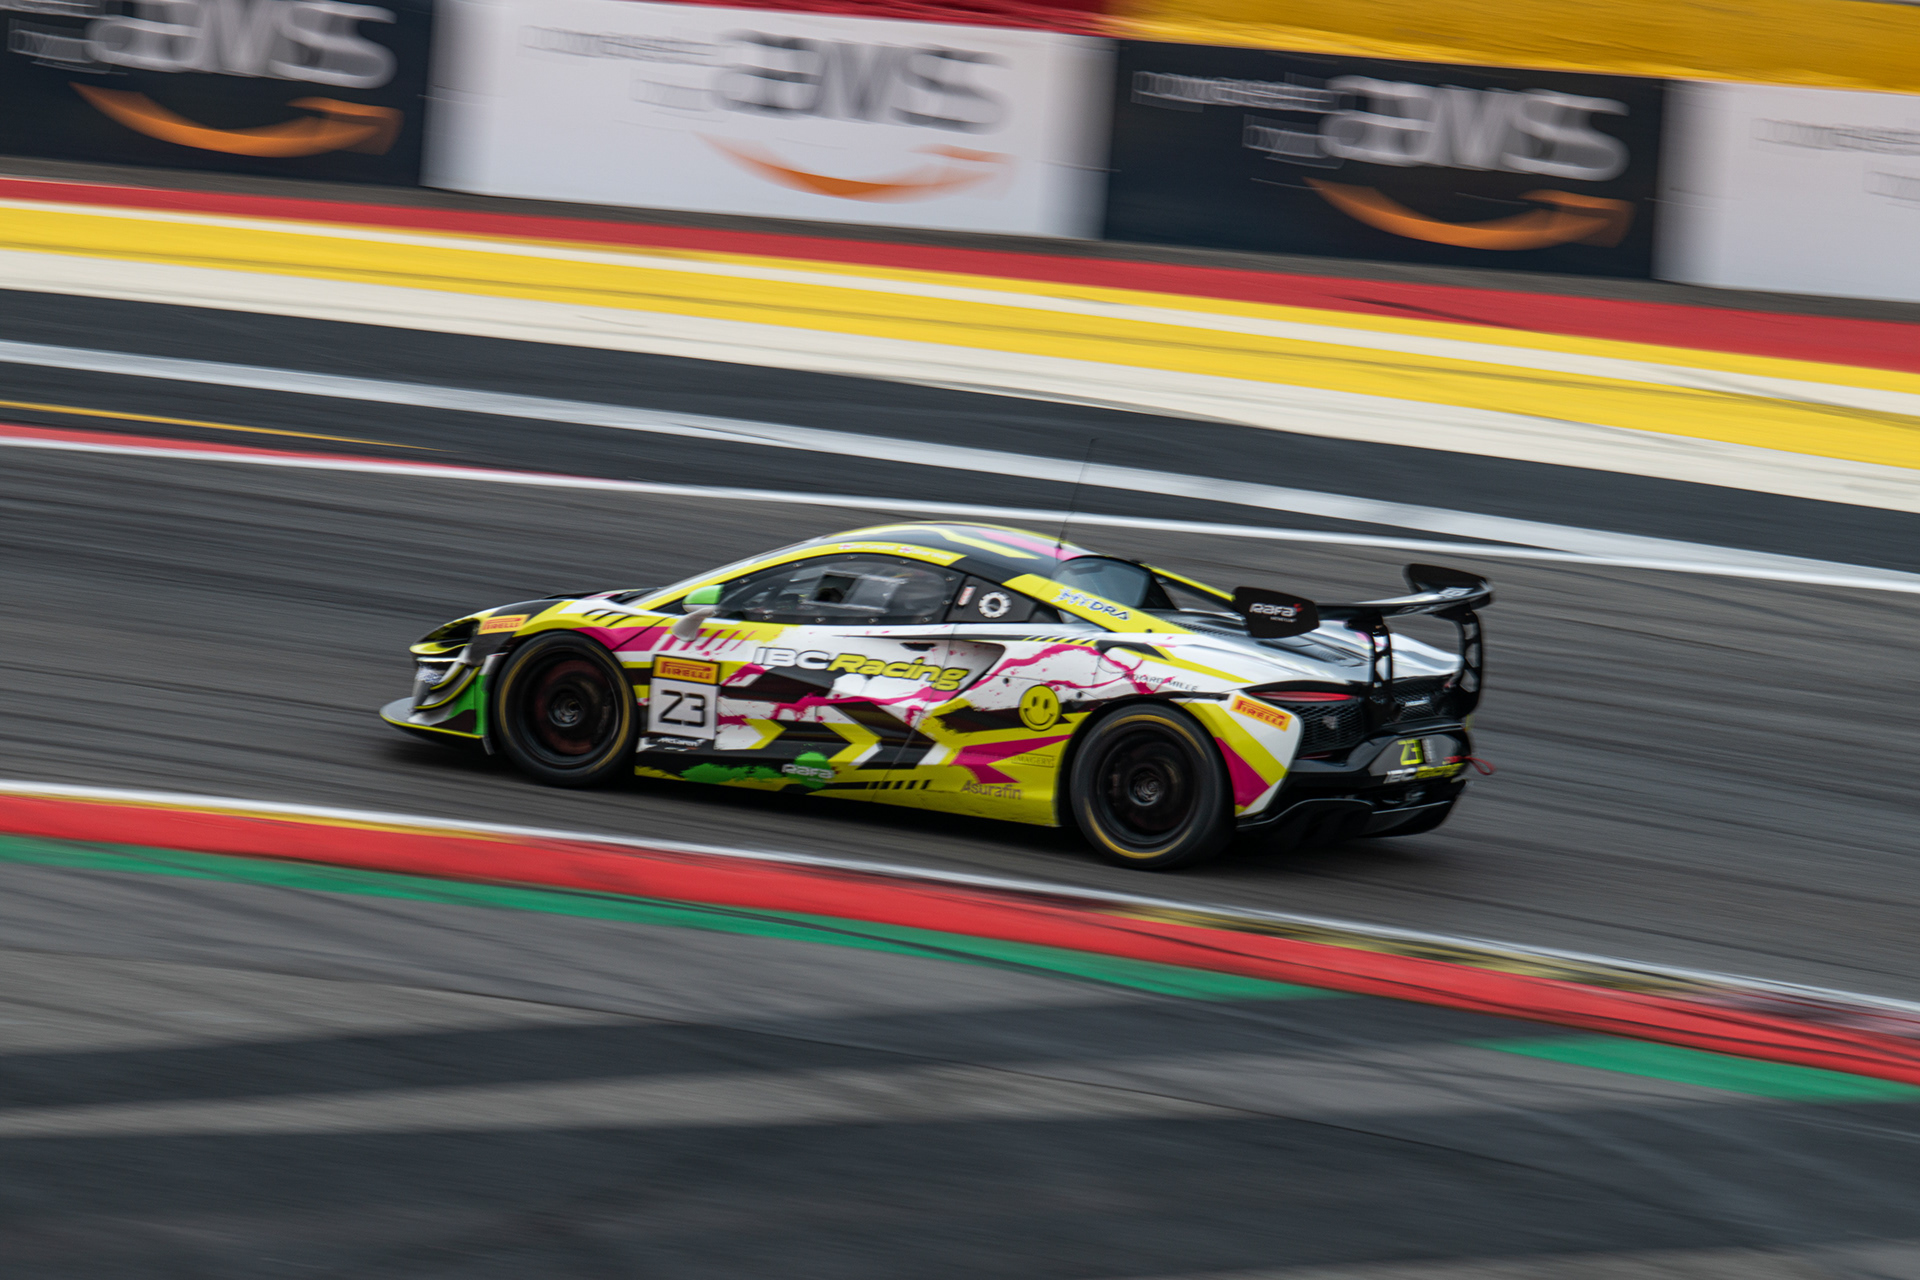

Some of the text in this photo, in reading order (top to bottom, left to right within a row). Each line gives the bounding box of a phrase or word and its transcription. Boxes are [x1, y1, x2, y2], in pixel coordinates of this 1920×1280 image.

[85, 0, 397, 89] aws
[711, 28, 1010, 134] aws
[1318, 75, 1629, 182] aws
[483, 617, 522, 631] PIRELLI
[660, 661, 713, 680] PIRELLI
[658, 689, 706, 728] 23
[1235, 700, 1286, 727] PIRELLI
[1397, 739, 1425, 766] 23
